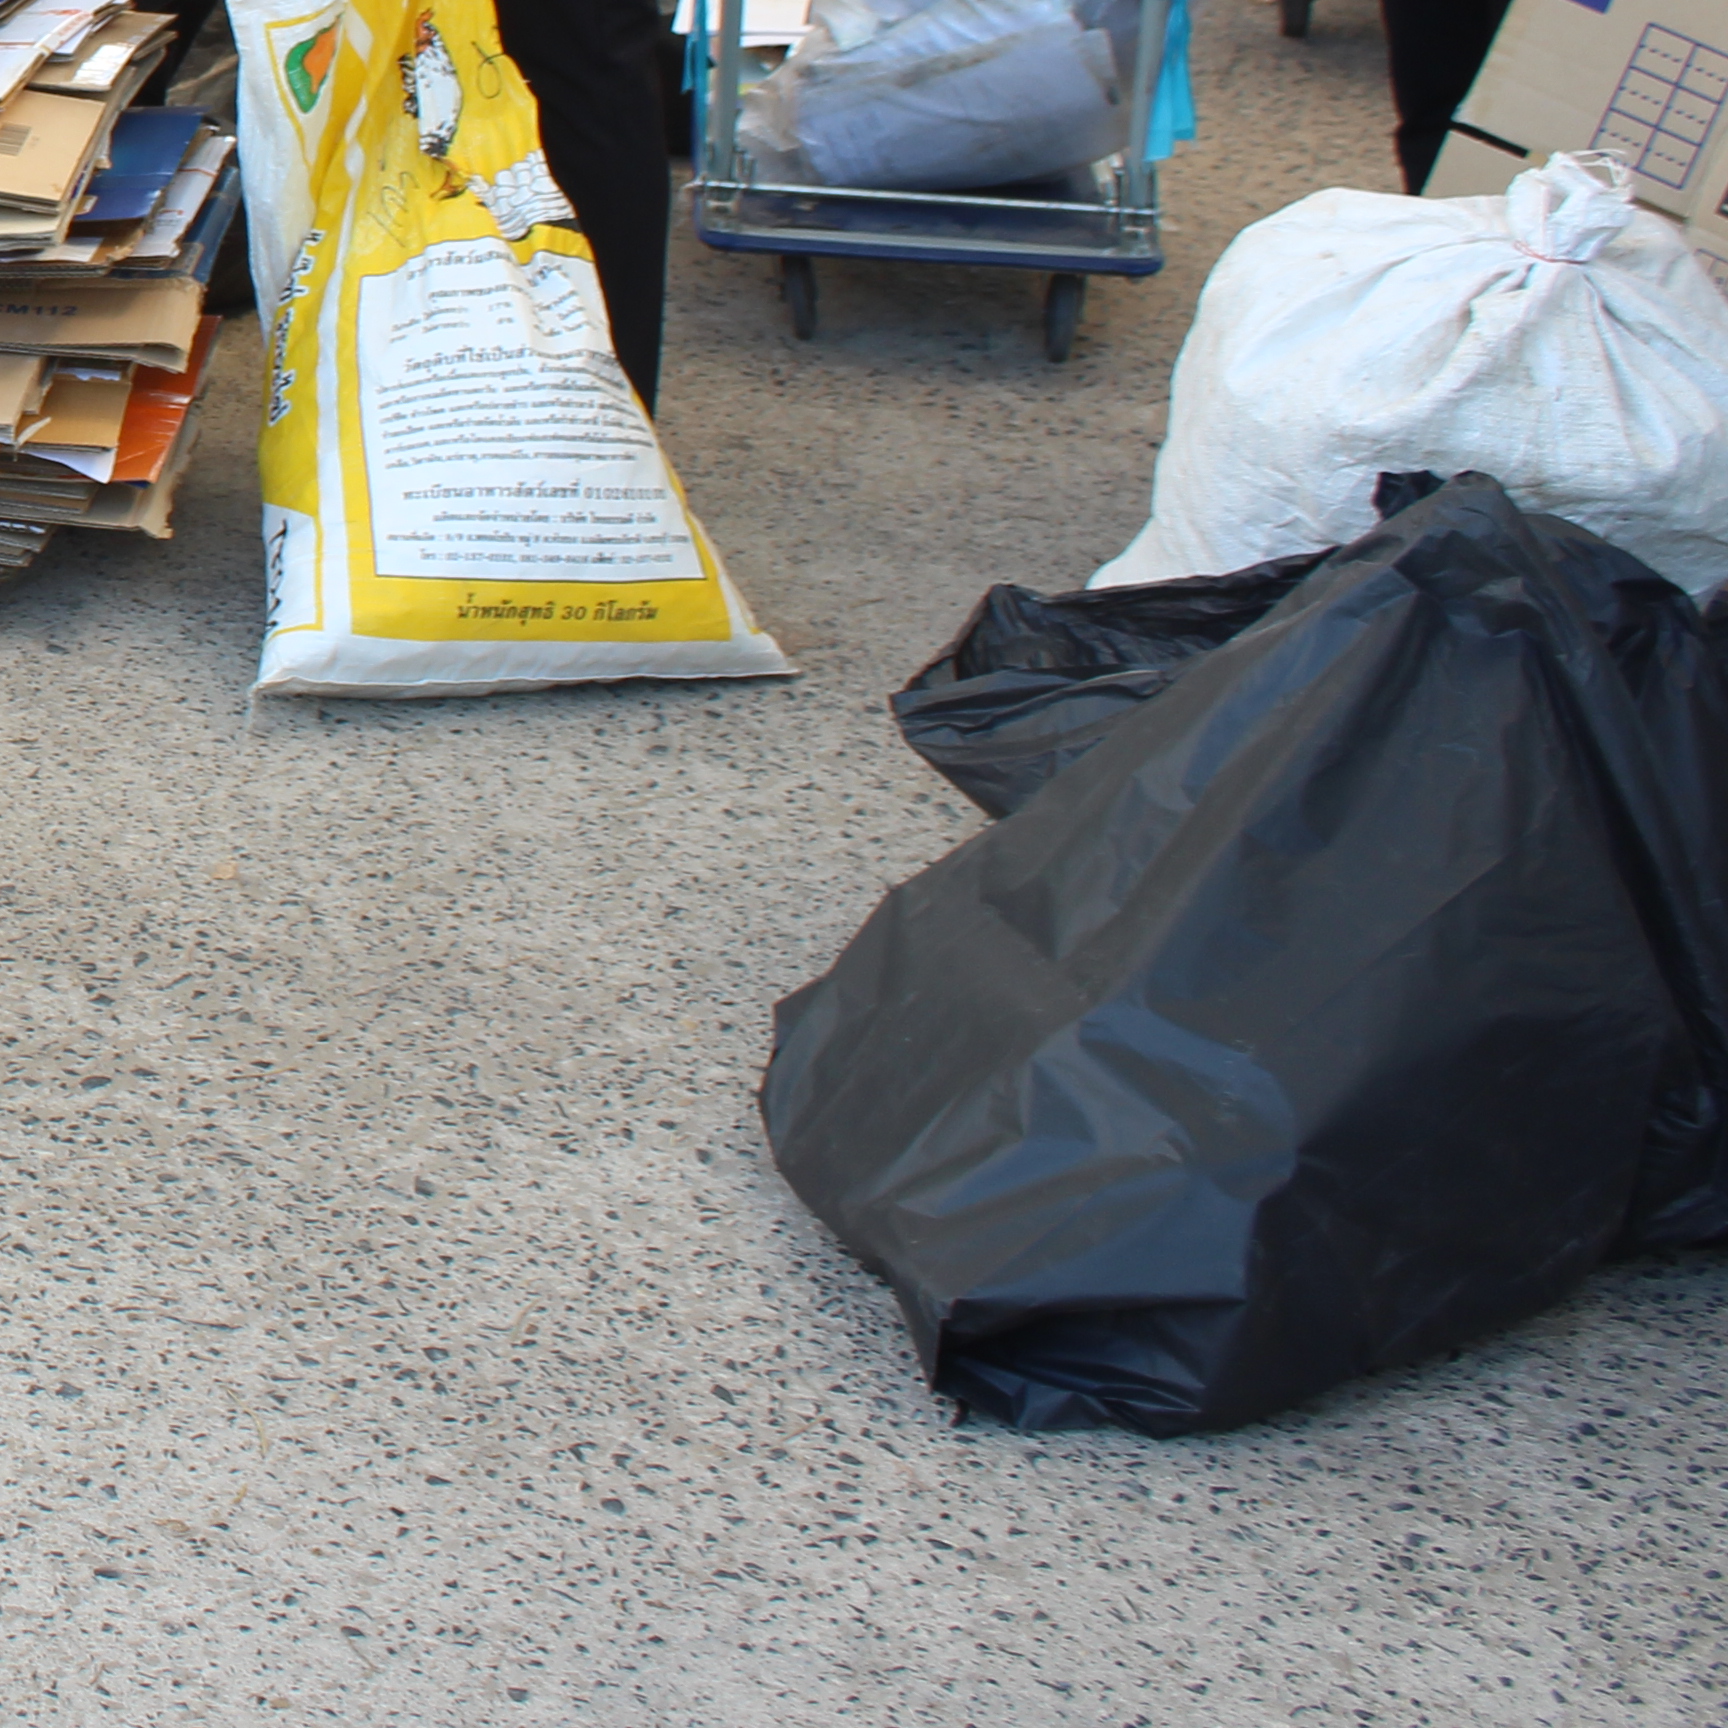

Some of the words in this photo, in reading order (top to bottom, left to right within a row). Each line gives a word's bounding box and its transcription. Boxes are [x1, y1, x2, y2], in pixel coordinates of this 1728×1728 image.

[561, 605, 587, 621] 30
[593, 599, 660, 622] กิโลกรัม
